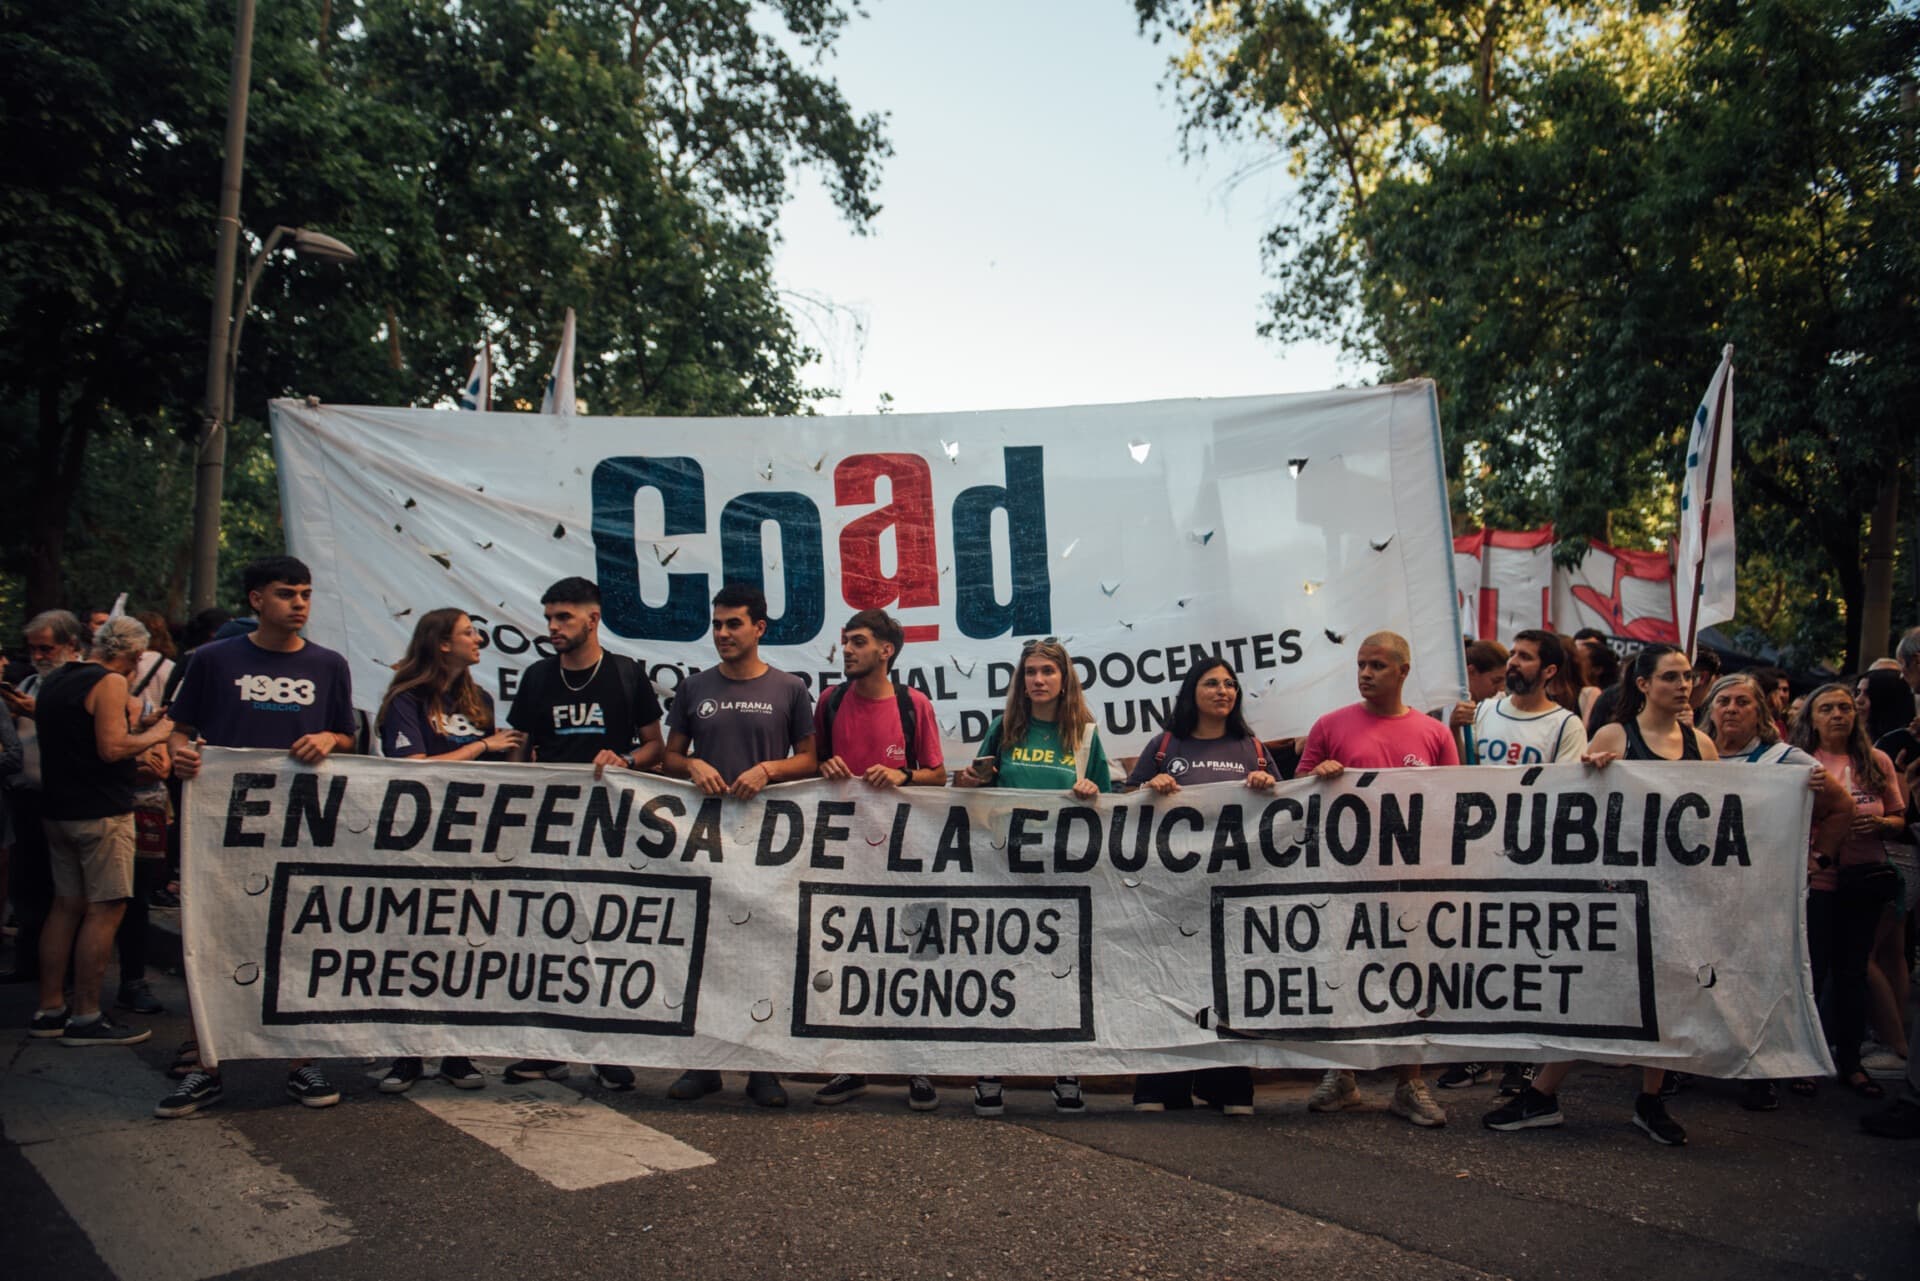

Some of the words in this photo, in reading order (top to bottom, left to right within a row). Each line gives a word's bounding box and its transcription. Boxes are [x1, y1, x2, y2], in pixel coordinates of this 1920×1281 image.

[235, 674, 316, 705] 1983
[253, 702, 301, 712] DERECHO
[552, 702, 605, 728] FUA
[735, 702, 773, 711] FRANJA
[1104, 696, 1179, 735] UN
[1207, 761, 1245, 770] FRANJA
[223, 773, 347, 848] EN
[374, 779, 724, 863] DEFENSA
[755, 800, 856, 869] DE
[887, 803, 974, 873] LA
[1007, 771, 1424, 874] EDUCACIÓN
[1451, 767, 1752, 867] PÚBLICA
[292, 885, 576, 939] AUMENTO
[591, 894, 686, 947] DEL
[821, 905, 1062, 957] SALARIOS
[1243, 902, 1320, 954] NO
[1345, 901, 1407, 951] AL
[1427, 902, 1618, 952] CIERRE
[307, 948, 657, 1010] PRESUPUESTO
[839, 965, 1017, 1018] DIGNOS
[1243, 966, 1334, 1018] DEL
[1357, 962, 1584, 1015] CONICET
